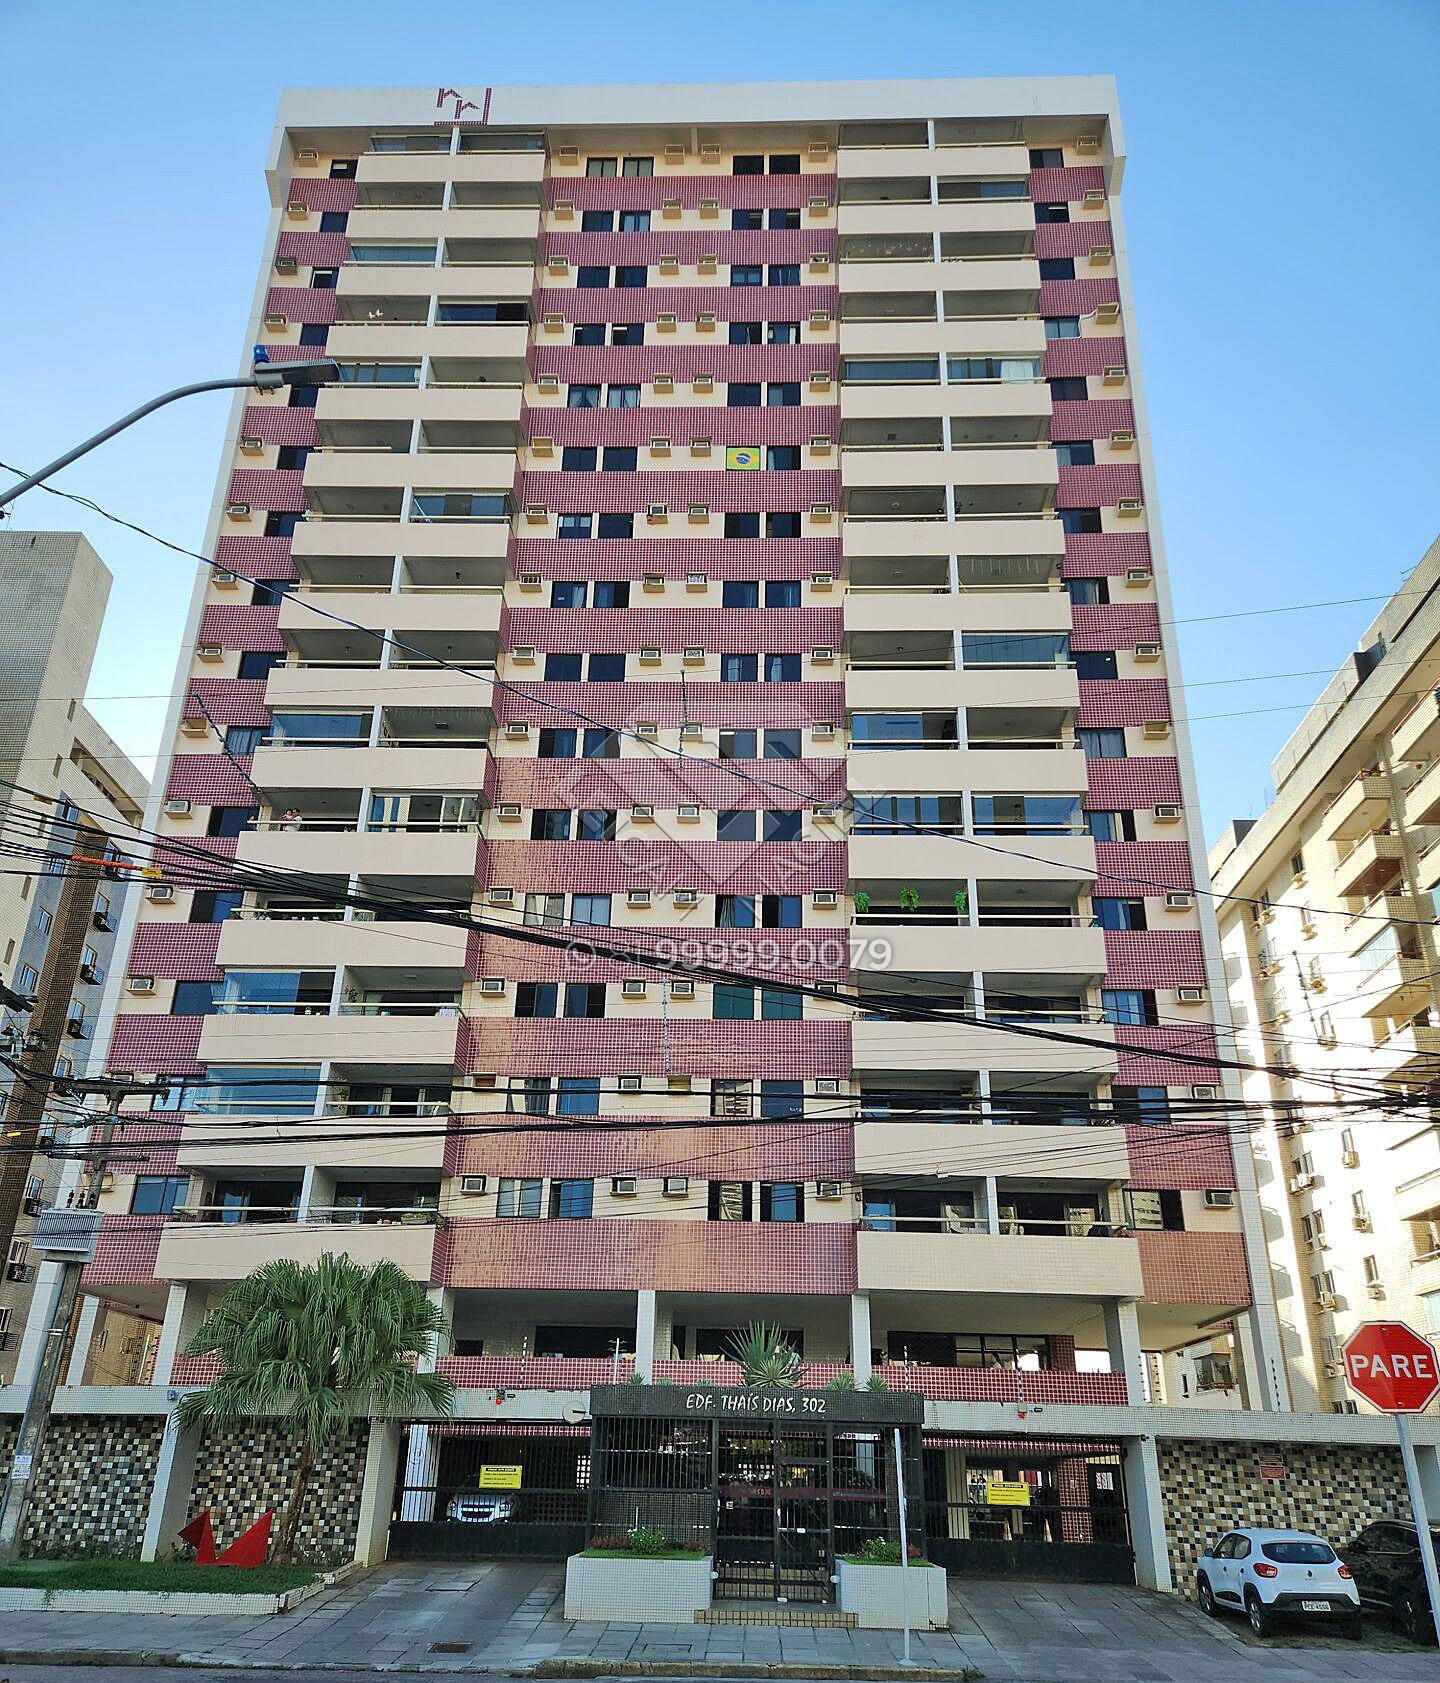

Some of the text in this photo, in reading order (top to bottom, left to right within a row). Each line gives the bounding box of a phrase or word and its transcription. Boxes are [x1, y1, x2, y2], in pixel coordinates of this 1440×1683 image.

[1349, 1354, 1433, 1379] PARE
[685, 1392, 827, 1414] EDF. THAÍS DIAS, 302
